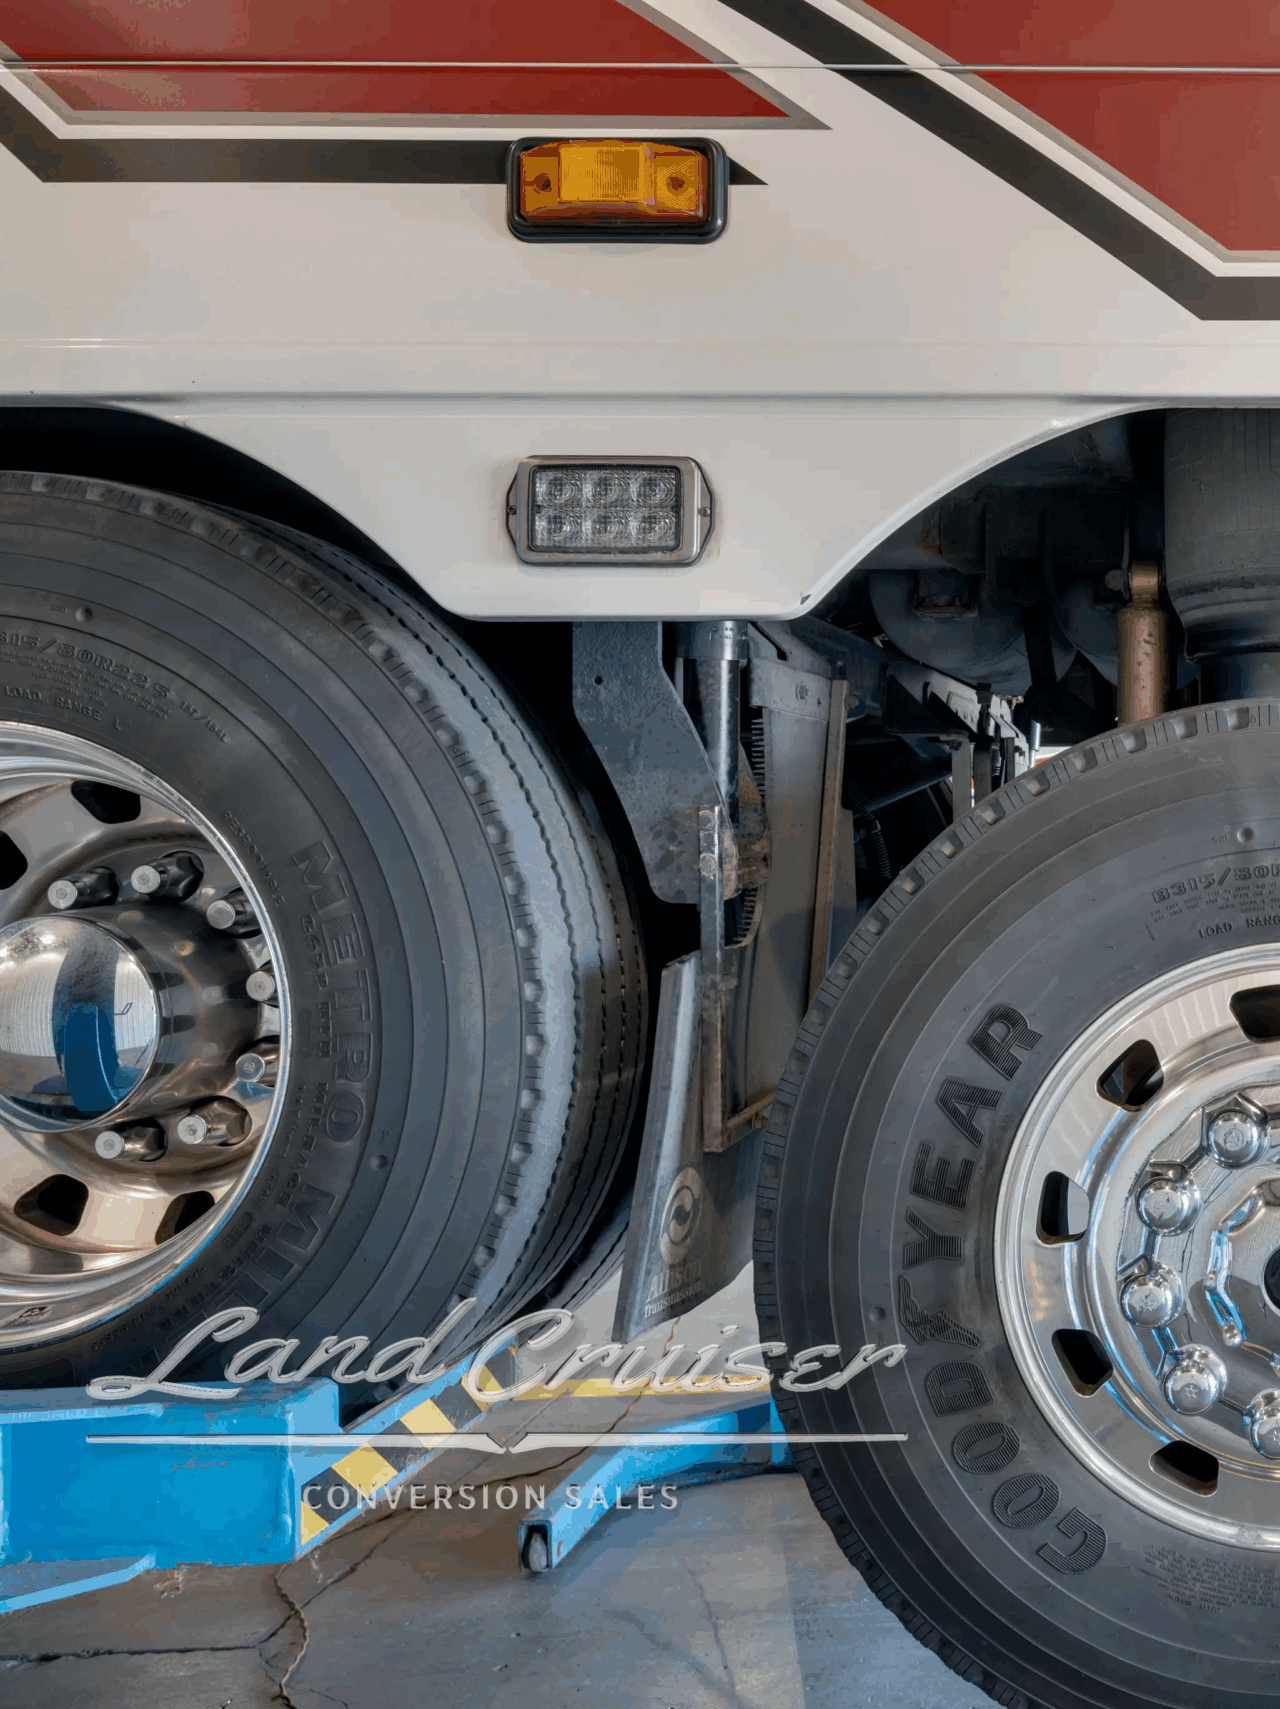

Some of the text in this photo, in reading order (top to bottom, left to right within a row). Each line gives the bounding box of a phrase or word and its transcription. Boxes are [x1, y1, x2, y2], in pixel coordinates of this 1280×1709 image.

[4, 685, 43, 702] LOAD
[53, 695, 103, 722] RANGE
[1198, 921, 1235, 939] LOAD
[292, 840, 374, 1143] METRO
[646, 1258, 703, 1304] Allison
[901, 1004, 1108, 1574] GOODYEAR
